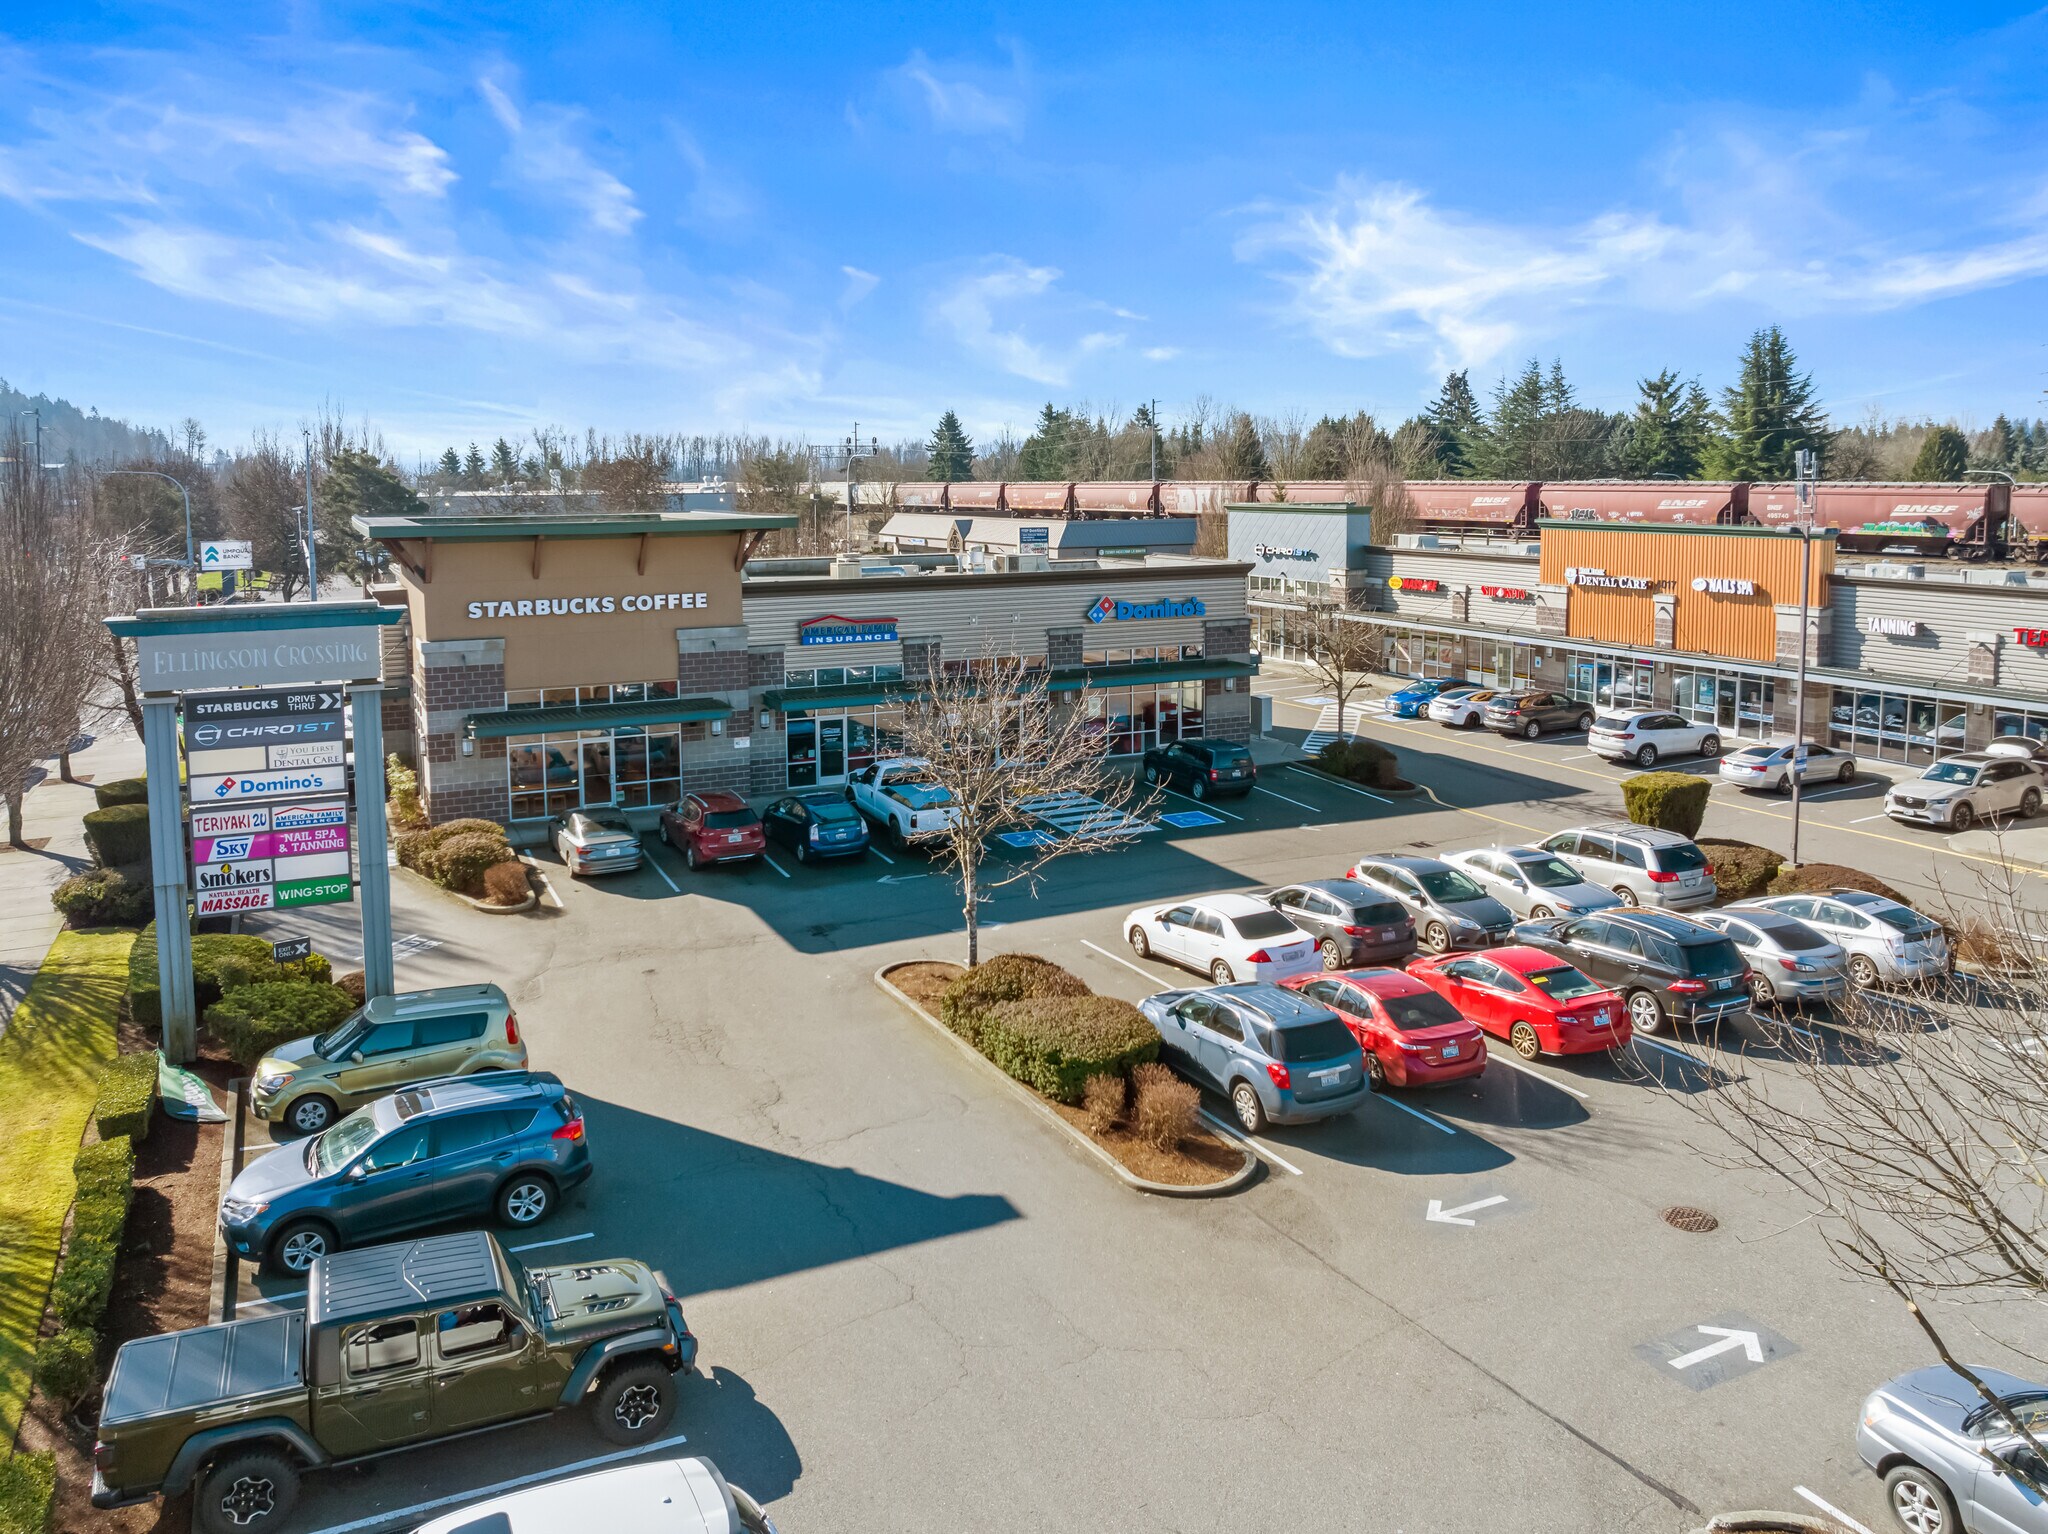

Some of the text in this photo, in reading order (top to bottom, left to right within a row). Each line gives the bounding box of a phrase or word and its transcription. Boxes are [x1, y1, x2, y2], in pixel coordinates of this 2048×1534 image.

[1659, 499, 1709, 507] BNSF
[1894, 504, 1959, 513] BNSF
[1579, 574, 1647, 589] DENTAL CARE
[1709, 579, 1735, 594] NAILS
[1736, 581, 1754, 595] SPA
[467, 592, 708, 619] STARBUCKS COFFEE
[1117, 597, 1206, 620] Domino's
[801, 623, 897, 636] AMERICAN FAMILY
[1867, 617, 1916, 636] TANNING
[809, 634, 891, 643] INSURANCE
[287, 694, 316, 703] DRIVE
[196, 700, 279, 714] STARBUCKS
[288, 702, 315, 711] THRU
[290, 745, 335, 755] YOU FIRST
[274, 755, 339, 768] DENTAL CARE
[240, 774, 323, 793] Domino's
[194, 813, 267, 833] TERIYAKI 2U
[275, 813, 315, 822] AMERICAN
[280, 817, 339, 827] INSURANCE
[284, 829, 337, 843] NAIL SPA
[278, 839, 344, 853] & TANNING
[237, 888, 260, 896] HEALTH
[201, 894, 269, 912] MASSAGE
